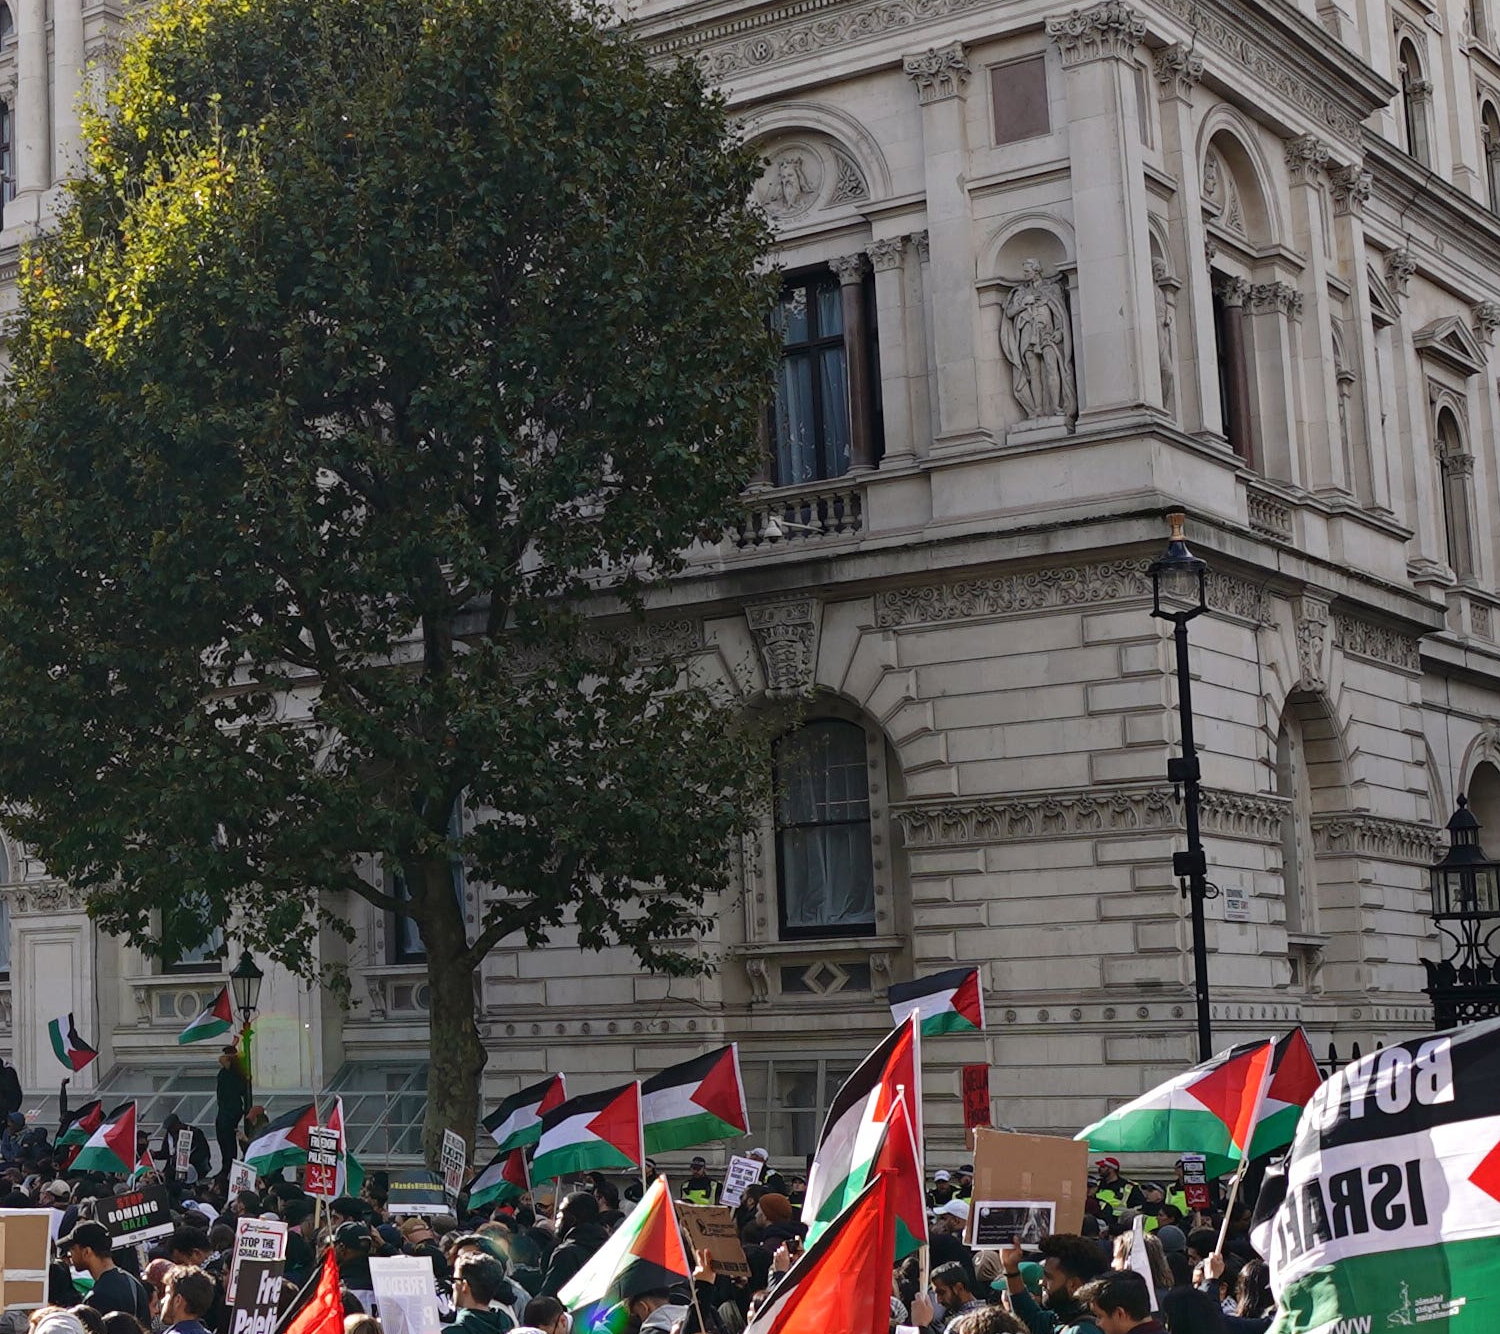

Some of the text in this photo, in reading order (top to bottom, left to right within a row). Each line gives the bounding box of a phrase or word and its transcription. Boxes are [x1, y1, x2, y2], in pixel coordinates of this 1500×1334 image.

[116, 1192, 144, 1208] STOP
[107, 1199, 159, 1224] BOMBING
[120, 1215, 150, 1231] GAZA
[240, 1235, 275, 1250] STOP THE
